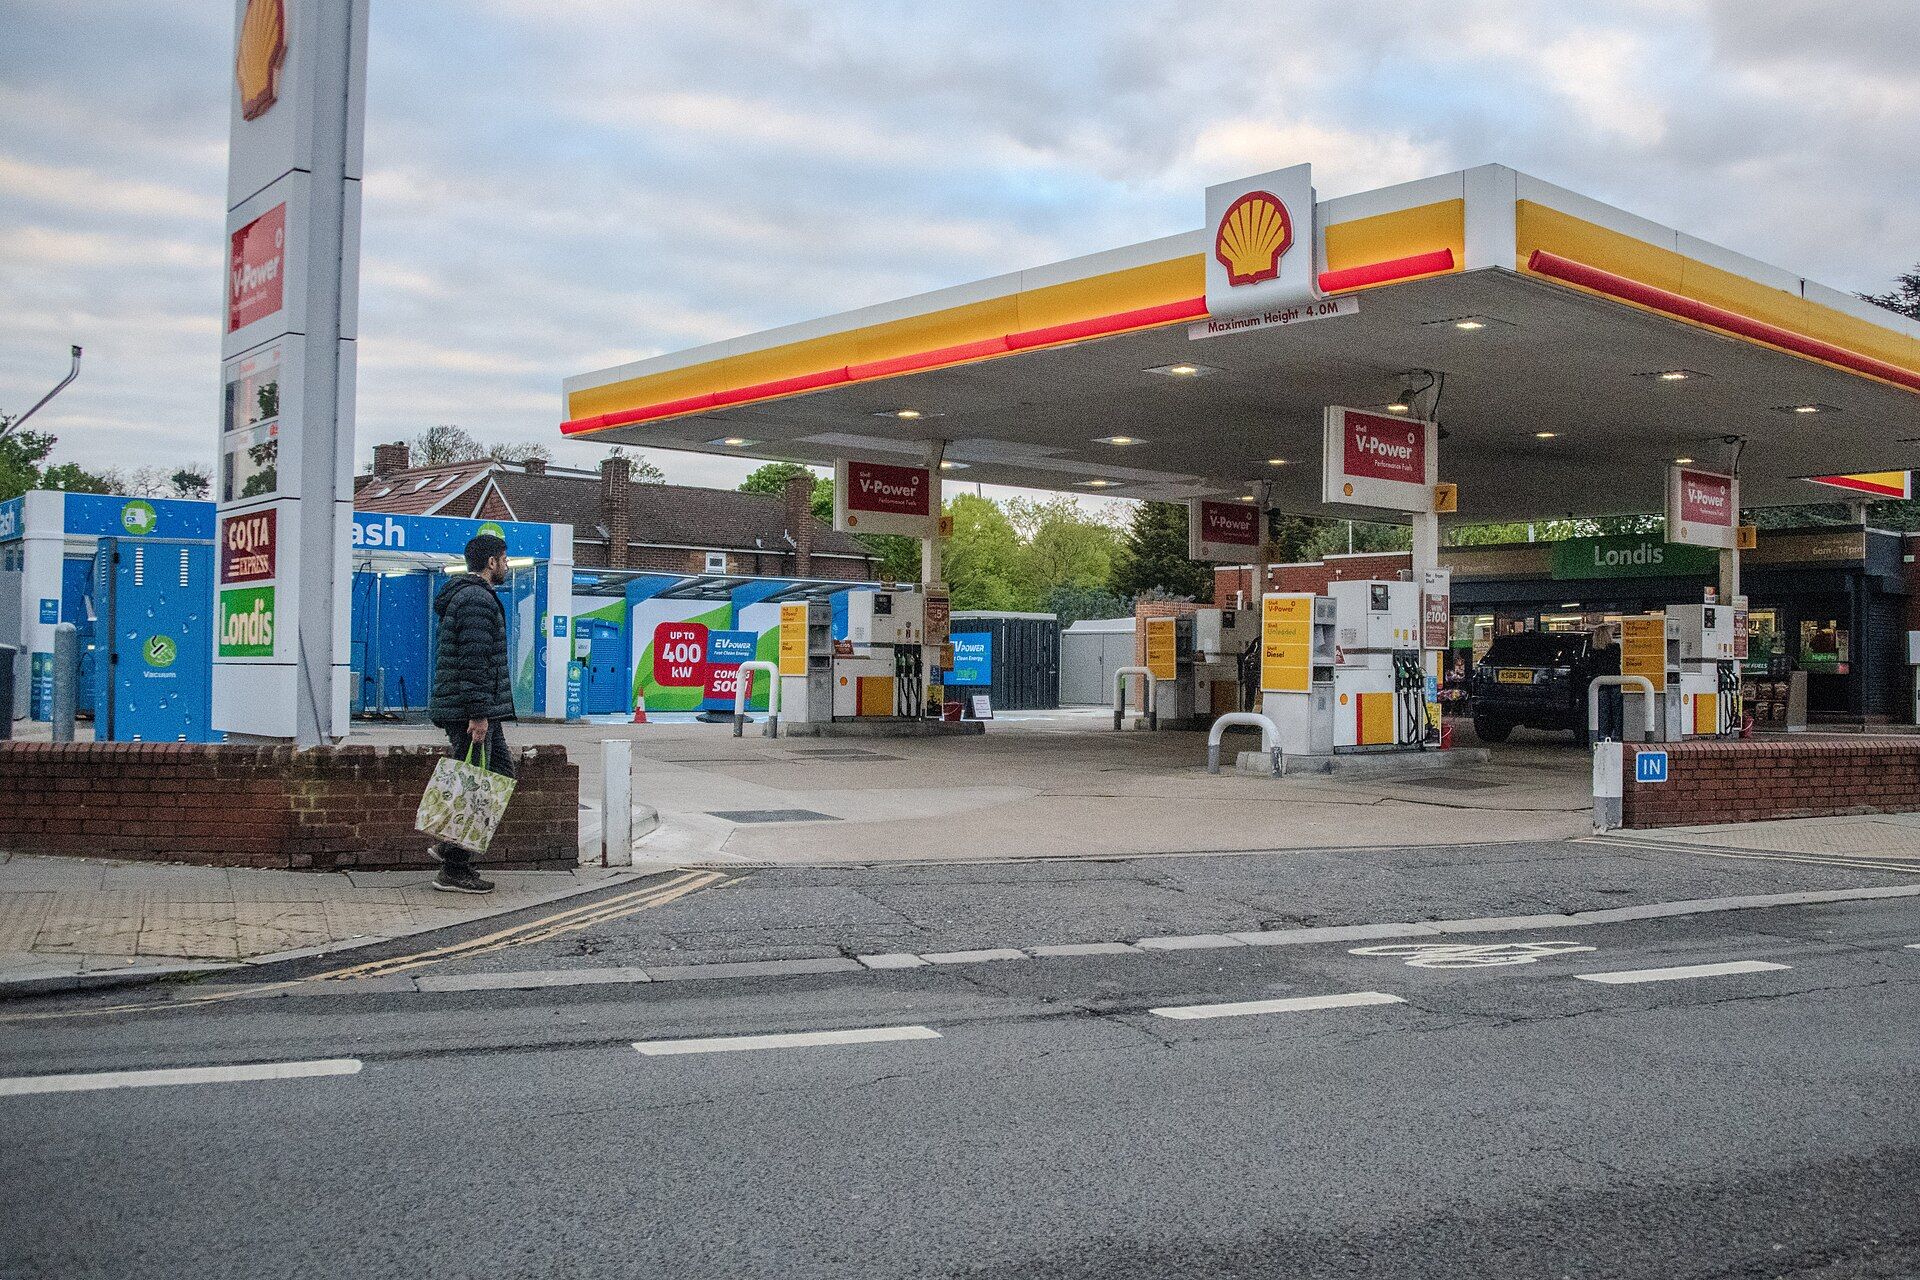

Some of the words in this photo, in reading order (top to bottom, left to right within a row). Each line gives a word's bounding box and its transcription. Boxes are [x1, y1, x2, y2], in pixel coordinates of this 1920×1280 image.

[233, 256, 280, 298] V-Power
[1207, 316, 1261, 333] Maximum
[1264, 309, 1299, 324] Height
[1306, 302, 1338, 317] 4.0M
[1355, 434, 1413, 460] V-Power
[860, 478, 917, 497] V-Power
[1439, 490, 1450, 506] 7
[1688, 488, 1724, 507] V-Power
[1209, 515, 1252, 531] V-Power
[228, 517, 269, 552] COSTA
[1594, 542, 1664, 566] Londis
[238, 554, 269, 576] EXPRESS
[220, 598, 273, 646] Londis
[670, 631, 682, 640] UP
[683, 631, 695, 640] TO
[662, 643, 701, 663] 400
[671, 666, 692, 678] kW
[712, 680, 749, 692] SOO
[1643, 759, 1661, 775] IN
